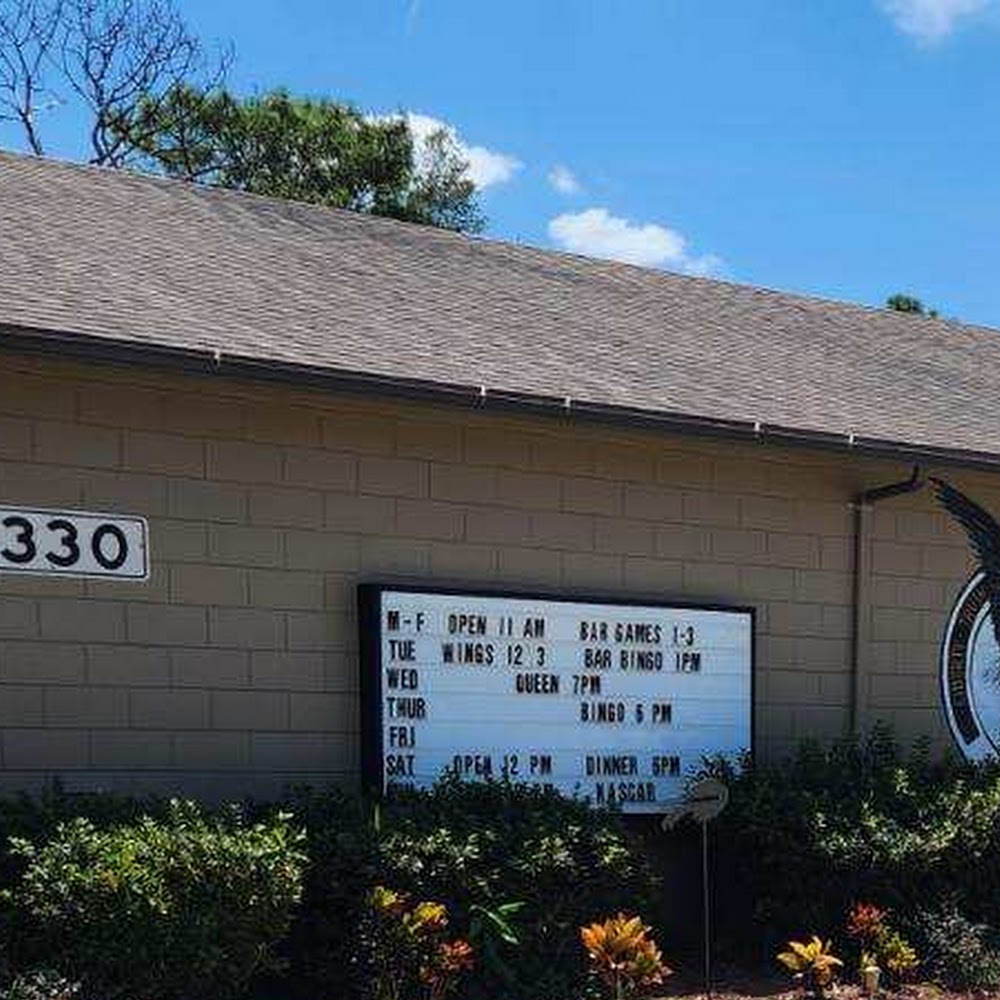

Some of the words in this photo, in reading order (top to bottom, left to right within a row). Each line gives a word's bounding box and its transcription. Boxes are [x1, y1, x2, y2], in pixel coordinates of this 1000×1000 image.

[2, 515, 128, 570] 330
[448, 614, 487, 636] OPEN
[523, 618, 545, 638] AM
[580, 621, 608, 643] BAR
[614, 623, 662, 644] GAMES
[673, 626, 695, 646] 1-3
[388, 640, 416, 661] TUE
[442, 642, 495, 665] WINGS
[584, 648, 612, 669] BAR
[620, 650, 663, 671] BINGO
[676, 652, 701, 672] 1PM
[387, 669, 418, 690] WED
[516, 673, 560, 694] QUEEN
[572, 675, 601, 695] 7PM
[387, 697, 426, 719] THUR
[581, 702, 625, 723] BINGO
[653, 703, 673, 723] PM
[389, 726, 416, 747] FRI
[386, 754, 416, 776] SAT
[453, 755, 492, 776] OPEN
[530, 755, 553, 776] PM
[585, 756, 639, 777] DINNER
